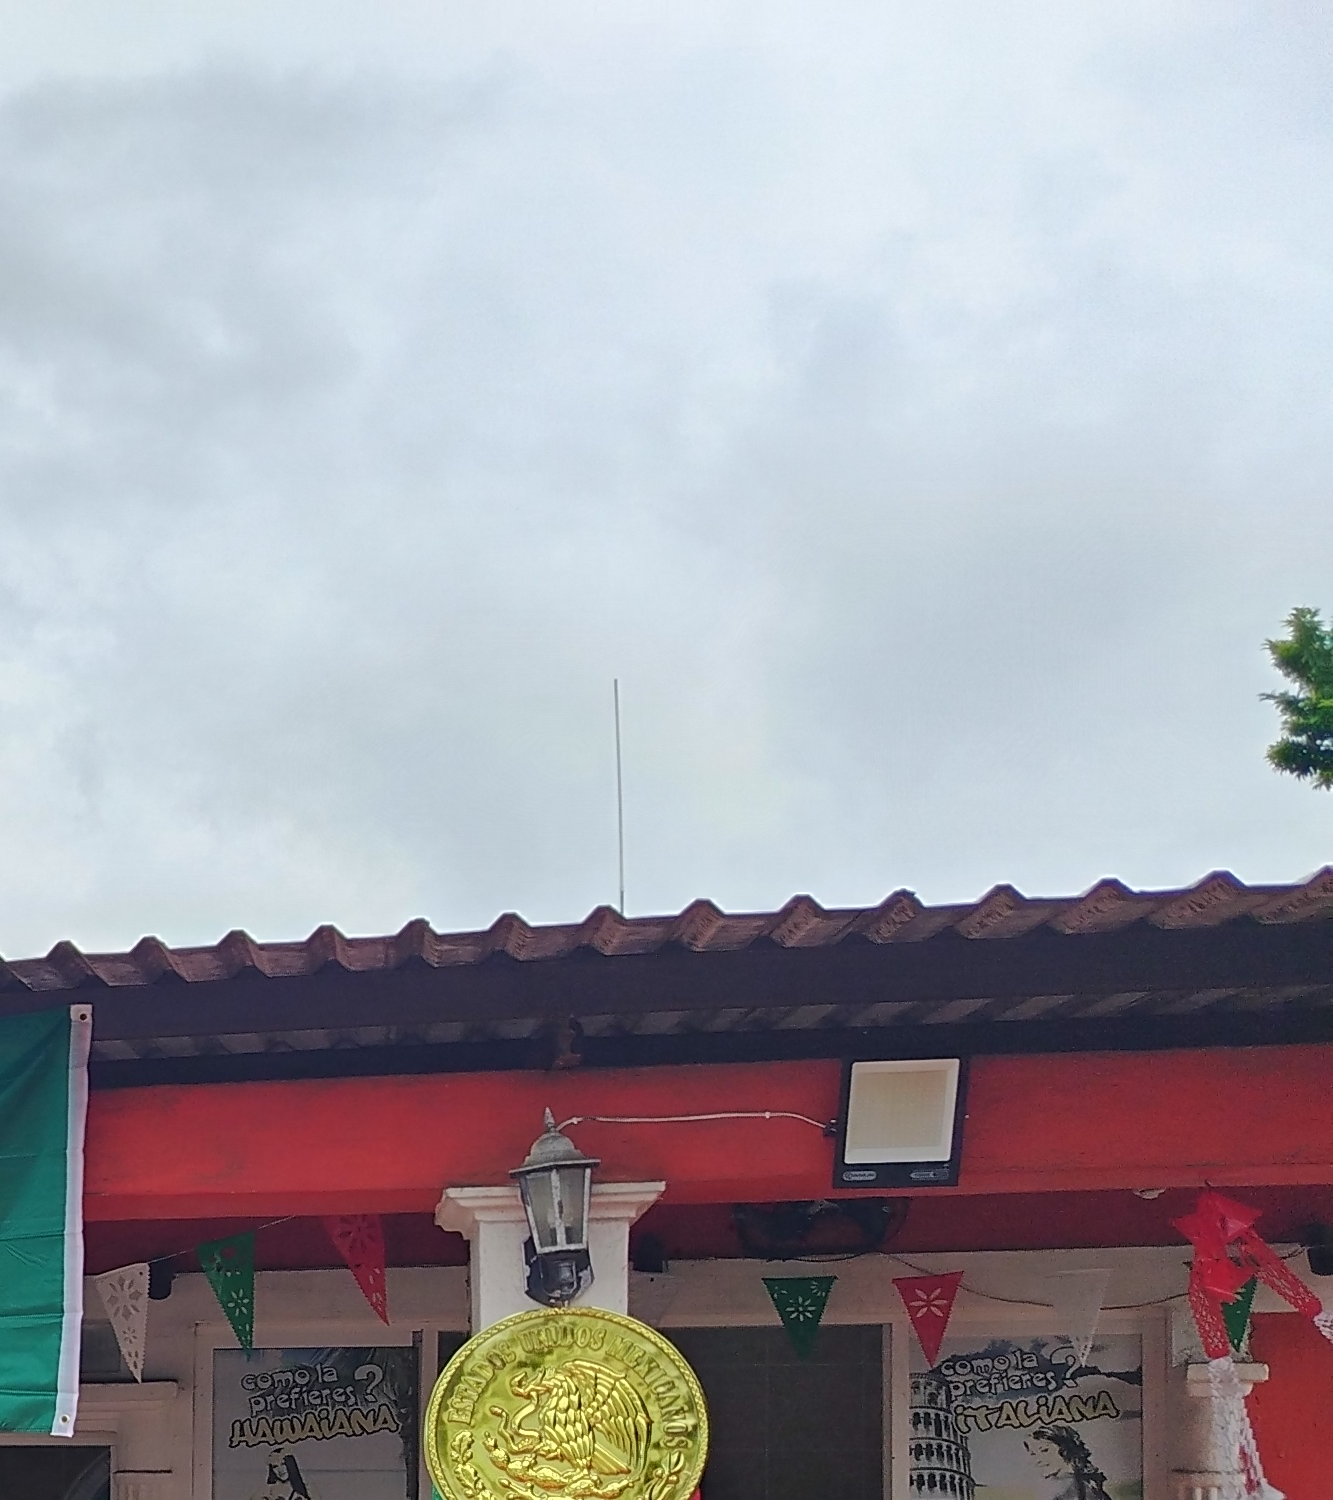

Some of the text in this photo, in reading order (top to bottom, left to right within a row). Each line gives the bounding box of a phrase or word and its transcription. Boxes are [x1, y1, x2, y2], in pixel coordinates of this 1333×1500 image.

[241, 1363, 338, 1391] como la
[941, 1351, 1038, 1377] como la
[447, 1325, 690, 1450] ESTADOS UNIDOS MEXICANOS
[949, 1370, 1057, 1400] prefieres
[248, 1385, 356, 1417] prefieres
